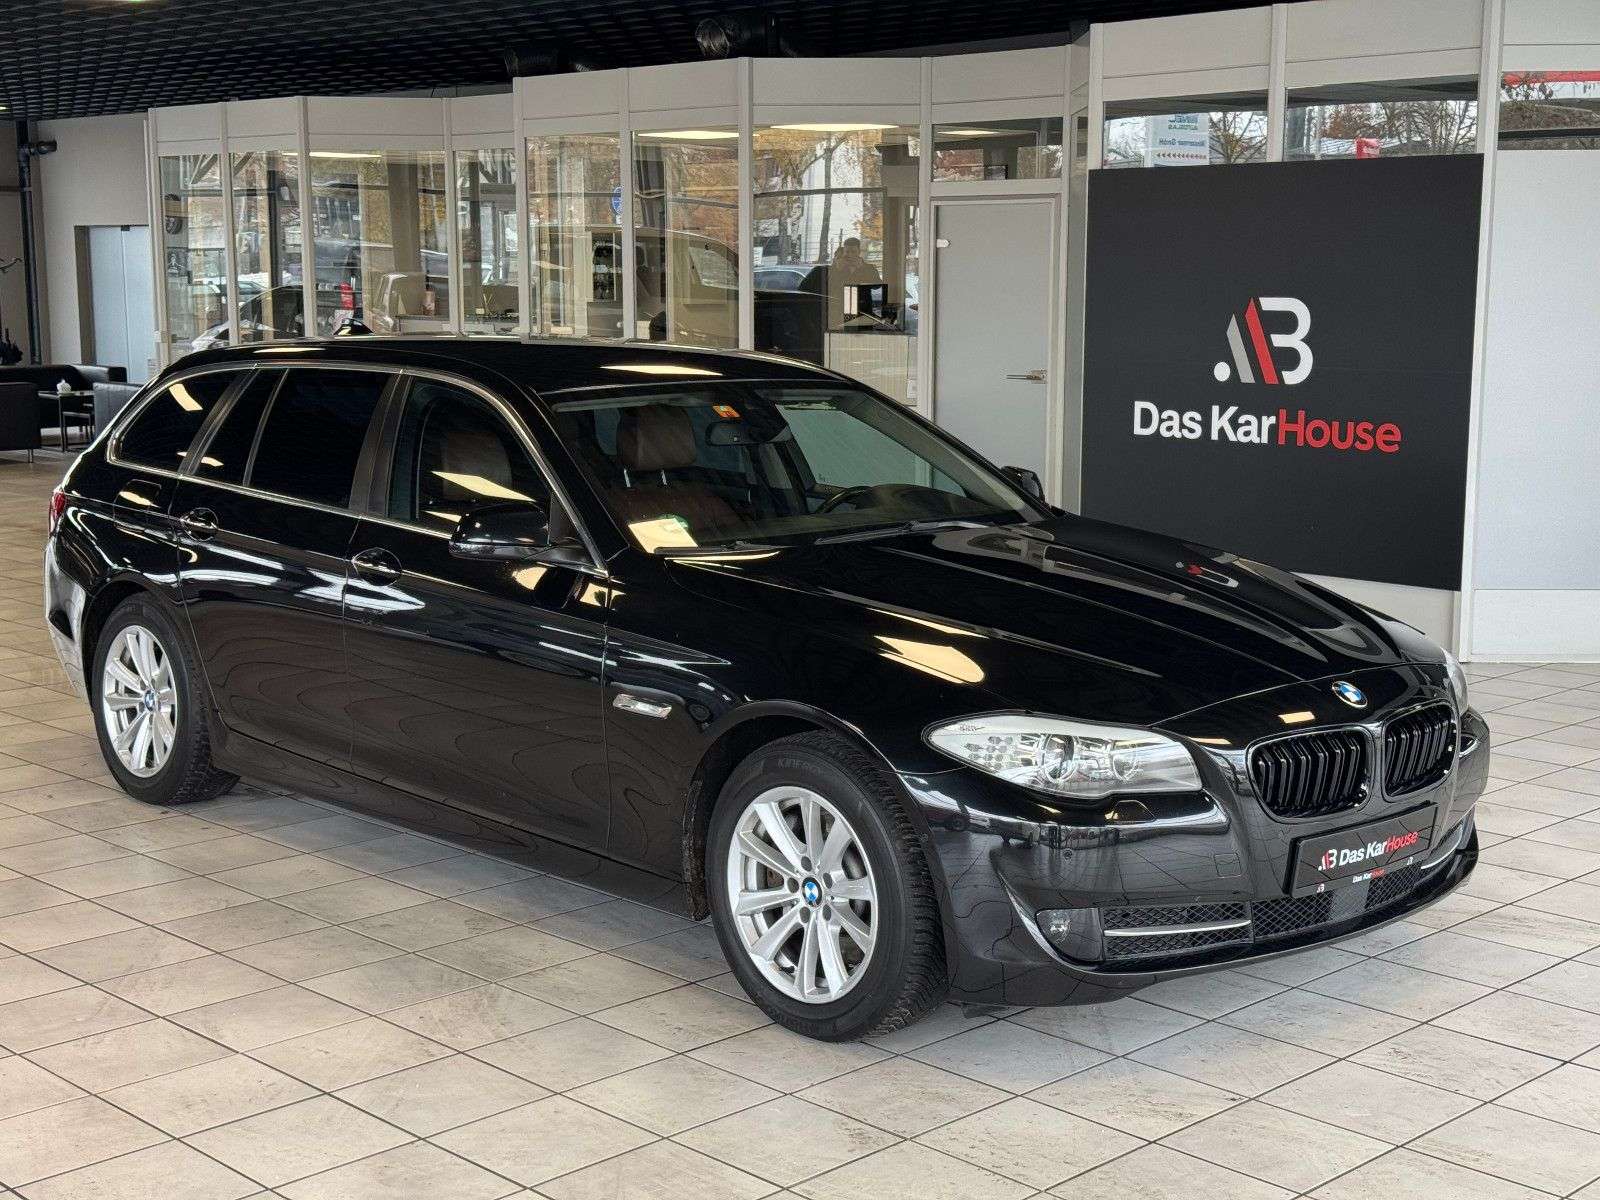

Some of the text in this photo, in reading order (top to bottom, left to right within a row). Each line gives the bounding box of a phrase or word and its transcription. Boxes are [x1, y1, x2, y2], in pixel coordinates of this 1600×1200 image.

[1133, 400, 1402, 453] Das KarHouse
[1339, 848, 1365, 867] Das
[1365, 831, 1419, 860] KarHouse
[1352, 875, 1363, 884] Das
